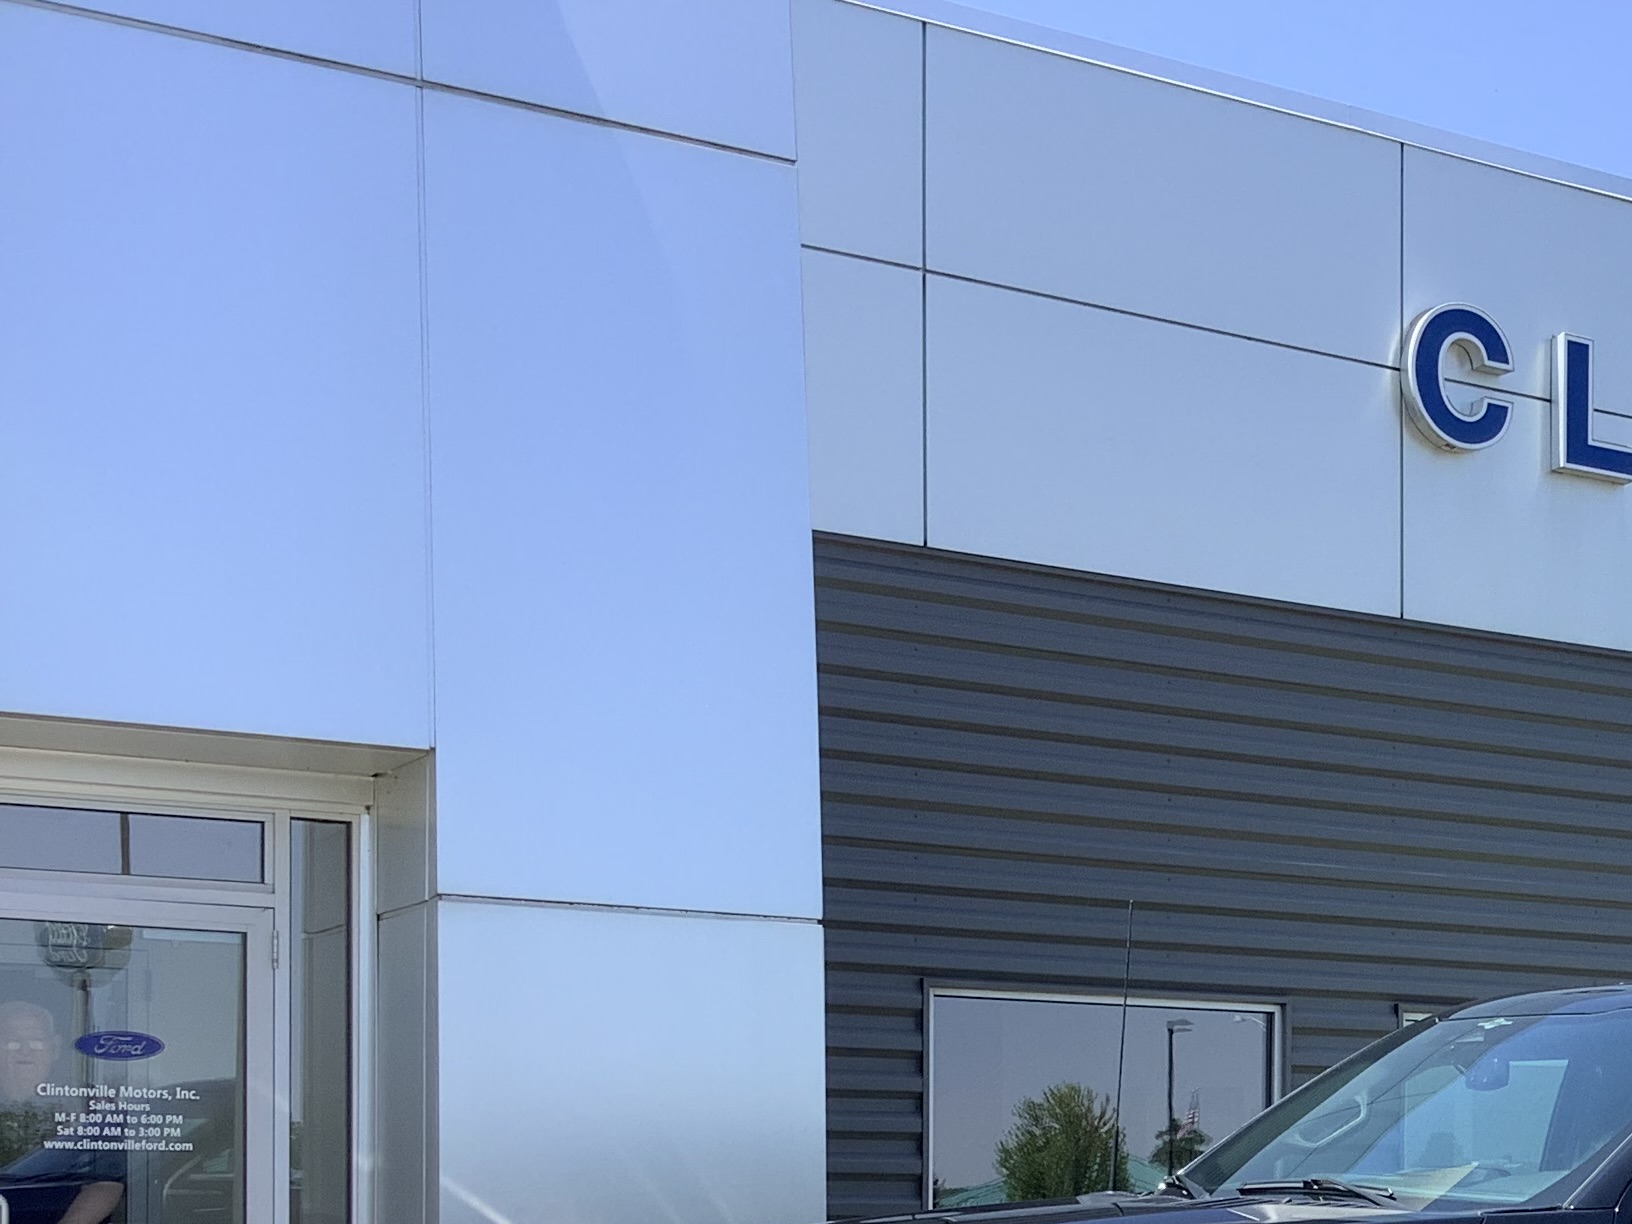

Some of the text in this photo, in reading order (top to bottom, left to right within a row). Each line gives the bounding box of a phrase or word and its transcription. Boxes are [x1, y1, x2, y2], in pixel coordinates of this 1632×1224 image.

[36, 1083, 200, 1101] Clintonville Motors, Inc.
[89, 1100, 150, 1111] Sales Hours
[54, 1112, 183, 1125] M-F 8:00 AM to 6:00 PM
[56, 1125, 181, 1138] Sat 8:00 AM to 3:00 PM
[43, 1139, 193, 1151] www.clintonvilleford.com
